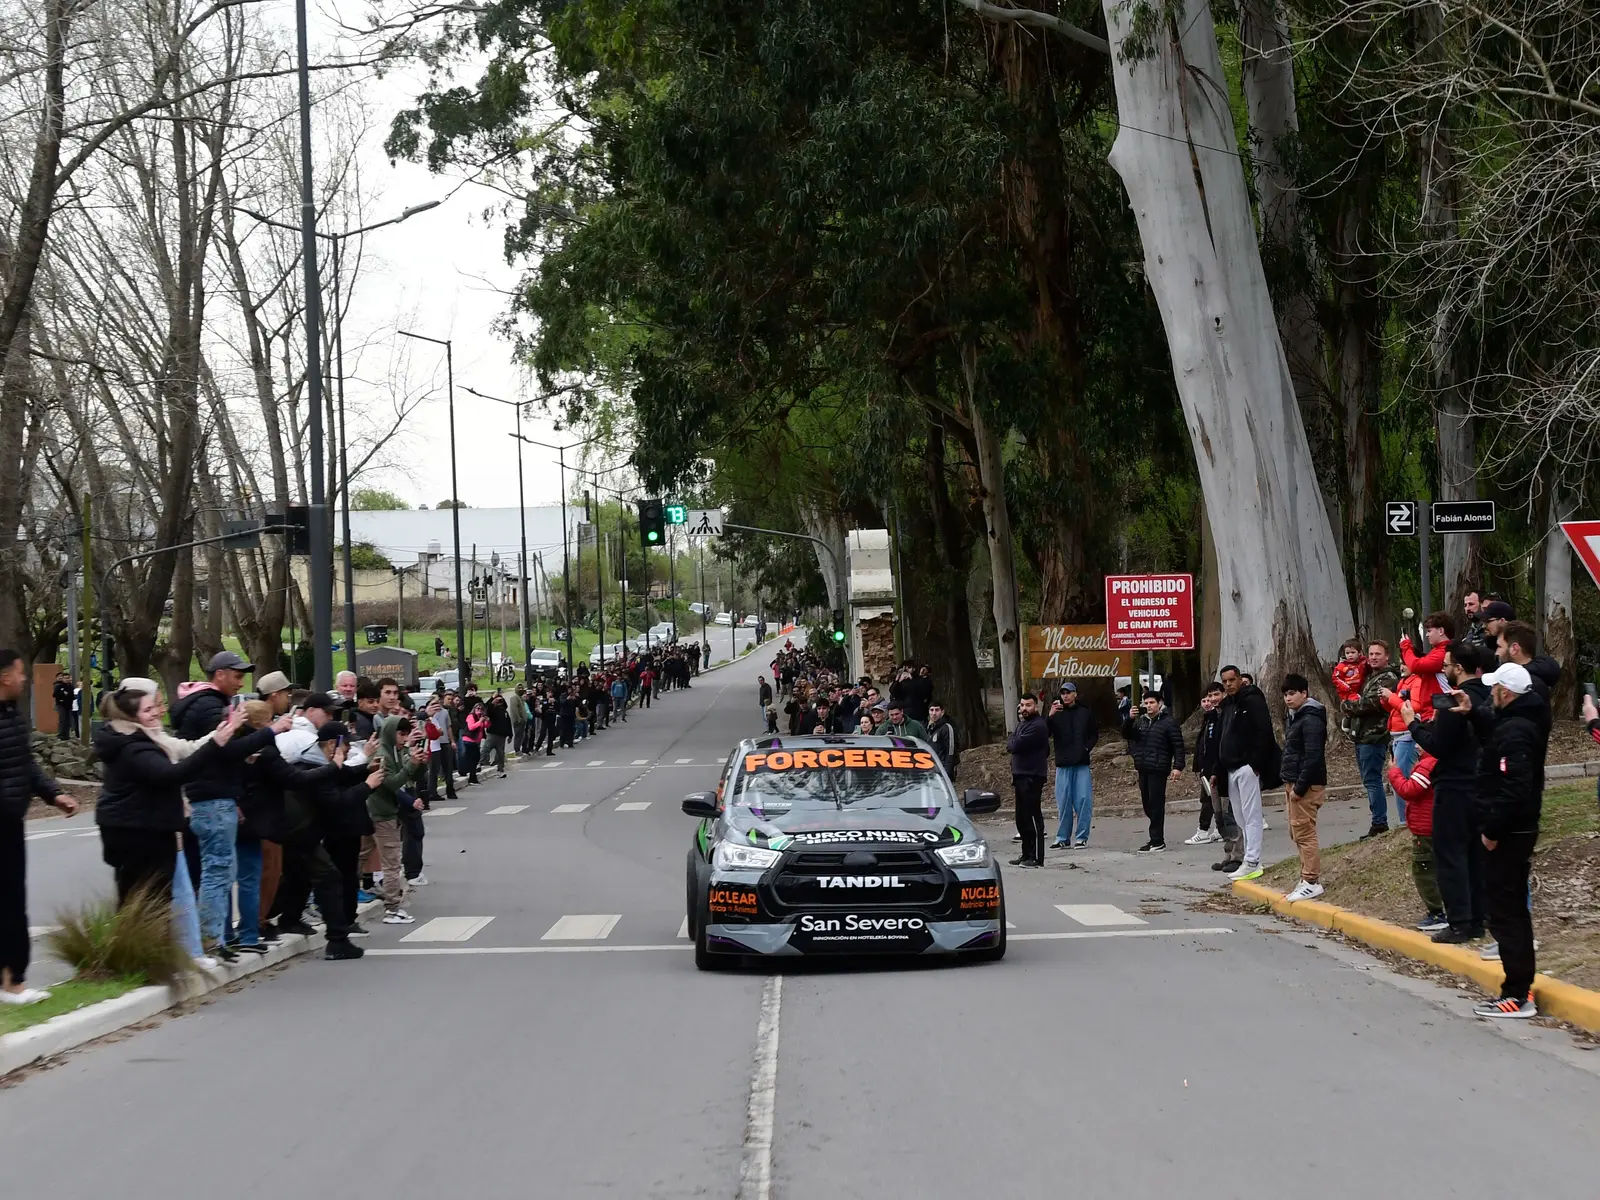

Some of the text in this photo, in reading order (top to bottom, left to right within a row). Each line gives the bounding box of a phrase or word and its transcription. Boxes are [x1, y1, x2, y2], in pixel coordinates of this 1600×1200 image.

[667, 507, 684, 523] 73
[1435, 514, 1492, 523] Fabián Alonso
[1112, 579, 1186, 594] PROHIBIDO
[1121, 597, 1178, 607] EL INGRESO DE
[1128, 608, 1171, 618] VEHICULOS
[1117, 620, 1178, 629] DE GRAN PORTE
[1041, 627, 1108, 650] Mercad
[1042, 653, 1120, 678] Artesanal
[745, 749, 936, 772] FORCERES
[794, 831, 940, 843] SURCO NUEVO
[806, 837, 856, 845] SEMBRA
[816, 876, 906, 888] TANDIL
[800, 914, 924, 932] San Severo
